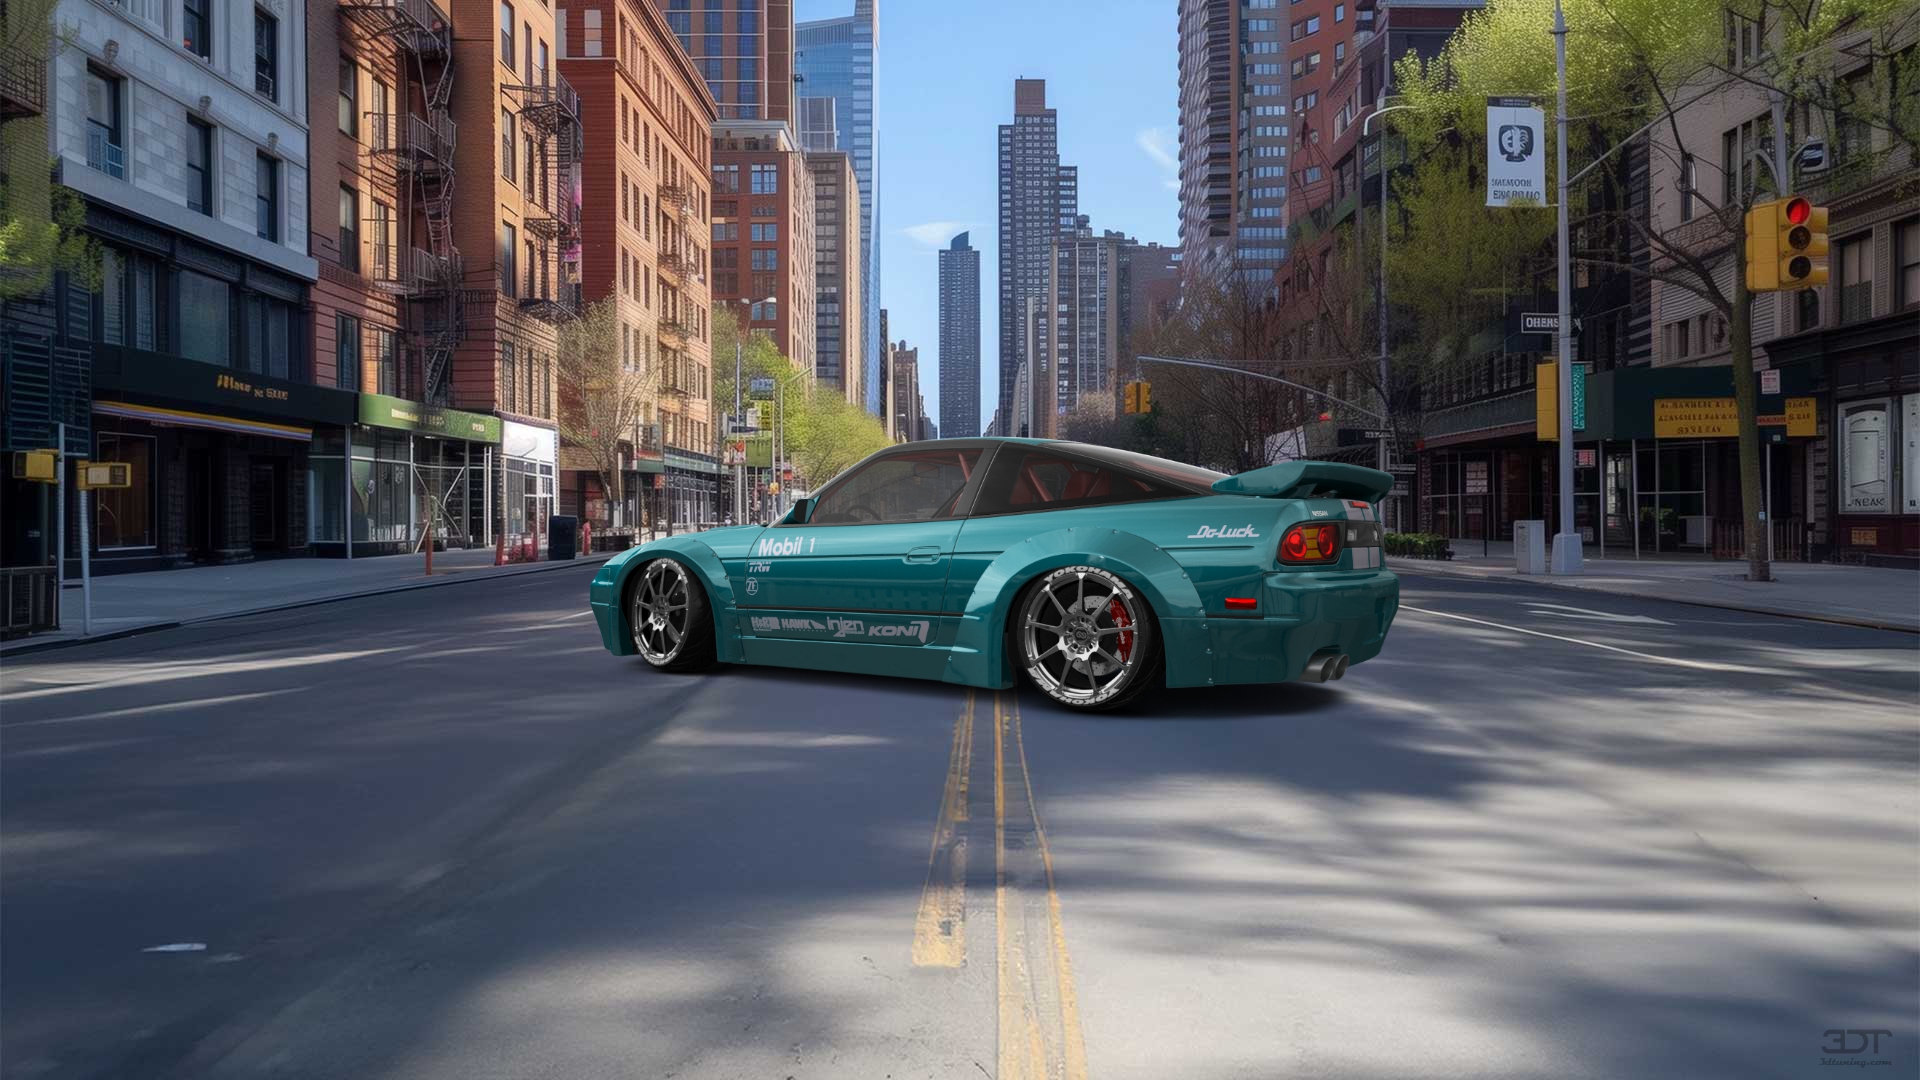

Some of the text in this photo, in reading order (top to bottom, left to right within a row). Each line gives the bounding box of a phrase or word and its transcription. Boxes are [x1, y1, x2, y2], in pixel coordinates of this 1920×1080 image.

[758, 536, 816, 556] Mobil 1
[749, 561, 772, 573] TRW
[747, 580, 758, 592] ZF
[1044, 566, 1134, 599] YOKOHAMA
[781, 618, 811, 629] HAWK
[868, 624, 921, 637] KONI
